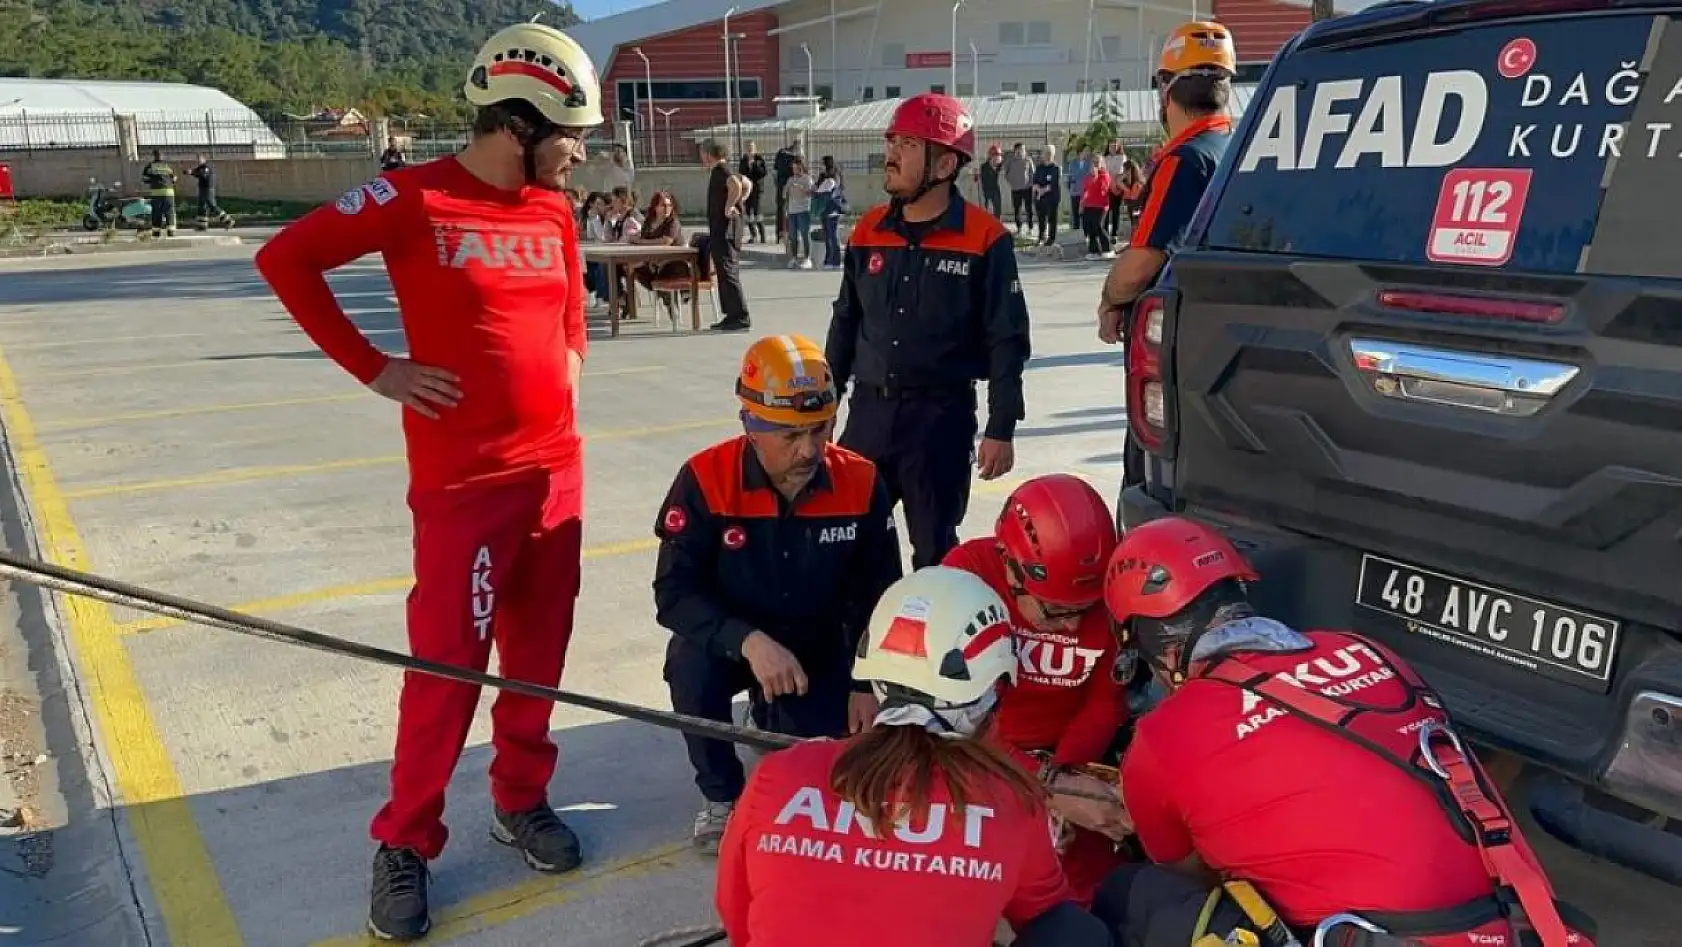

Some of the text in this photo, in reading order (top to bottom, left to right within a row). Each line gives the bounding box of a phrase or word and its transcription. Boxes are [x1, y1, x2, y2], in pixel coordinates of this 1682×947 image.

[1239, 69, 1488, 172] AFAD
[1507, 122, 1682, 158] KURT
[1452, 180, 1513, 222] 112
[937, 258, 970, 275] AFAD
[818, 523, 857, 544] AFAD
[472, 546, 494, 641] AKUT
[1381, 568, 1425, 616] 48
[1440, 585, 1513, 642] AVC
[1531, 608, 1607, 671] 106
[1016, 637, 1105, 675] KUT
[756, 834, 1004, 882] ARAMA KURTARMA
